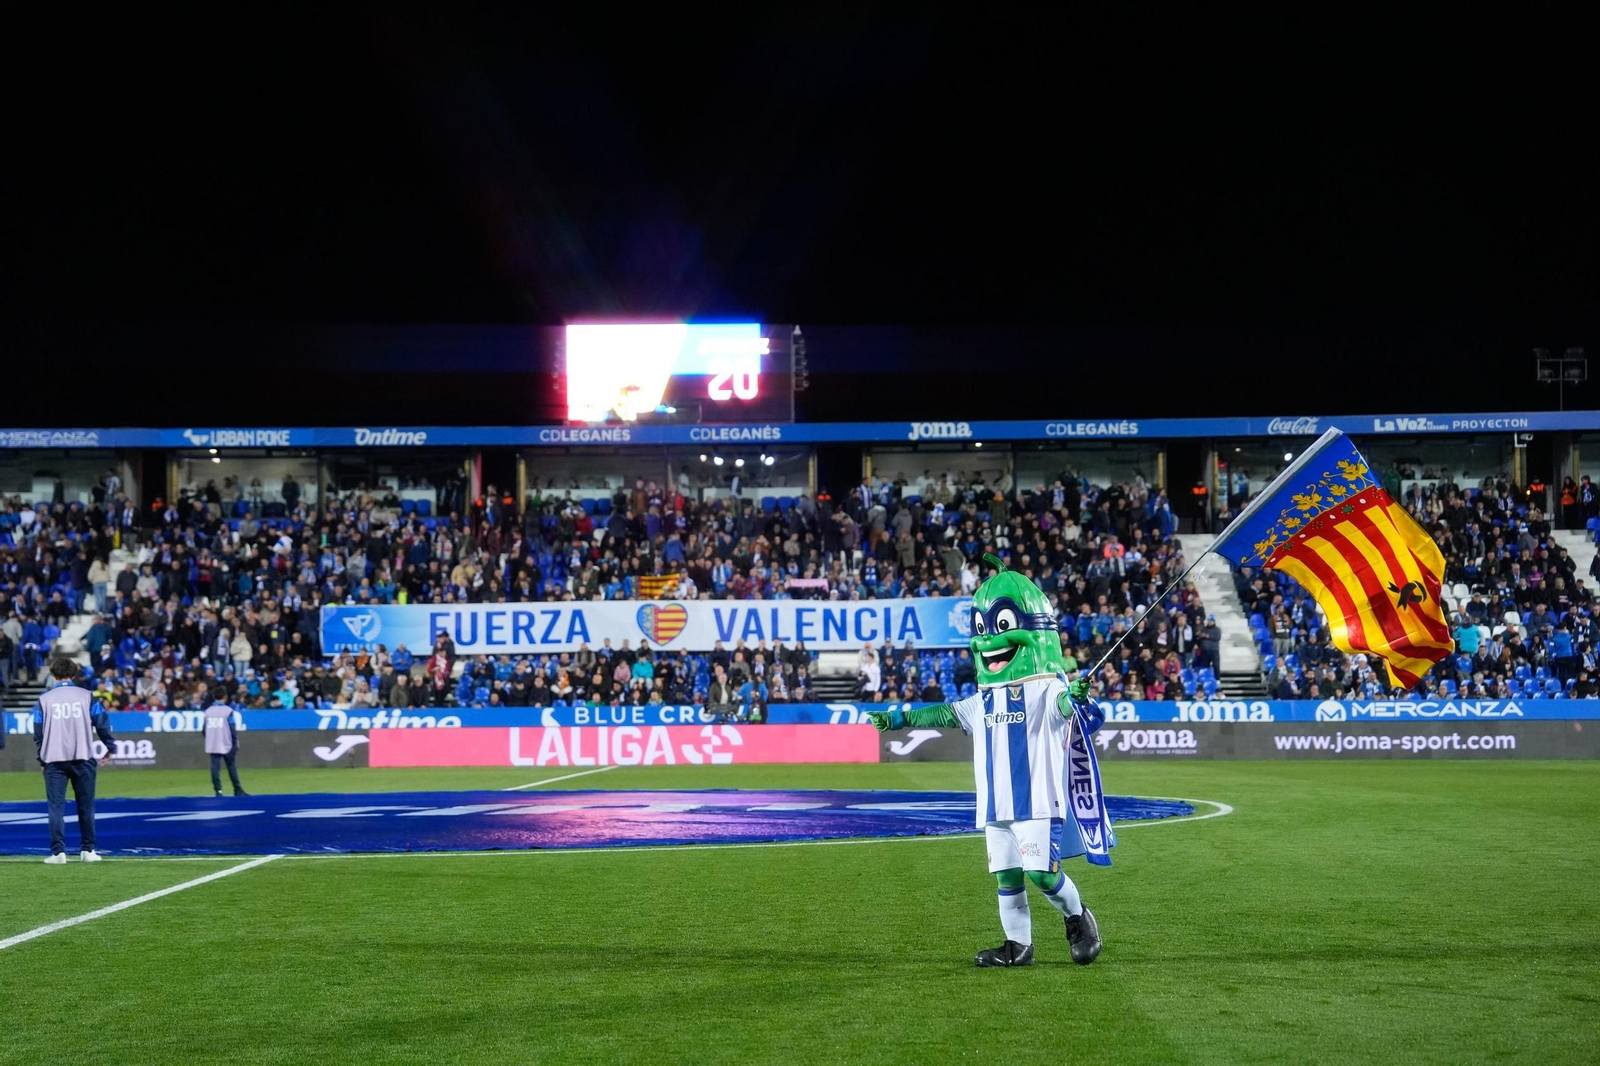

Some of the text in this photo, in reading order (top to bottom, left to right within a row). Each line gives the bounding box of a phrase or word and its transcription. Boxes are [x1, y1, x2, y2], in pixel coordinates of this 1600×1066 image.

[1452, 417, 1528, 429] PROYECTON
[211, 430, 290, 446] URBAN POKE
[354, 428, 427, 445] Ontime
[429, 609, 591, 646] FUERZA
[713, 606, 923, 642] VALENCIA
[52, 702, 82, 720] 305
[574, 706, 646, 724] BLUE
[92, 739, 156, 759] oma
[509, 726, 676, 767] LALIGA
[1274, 732, 1516, 753] www.joma-sport.com
